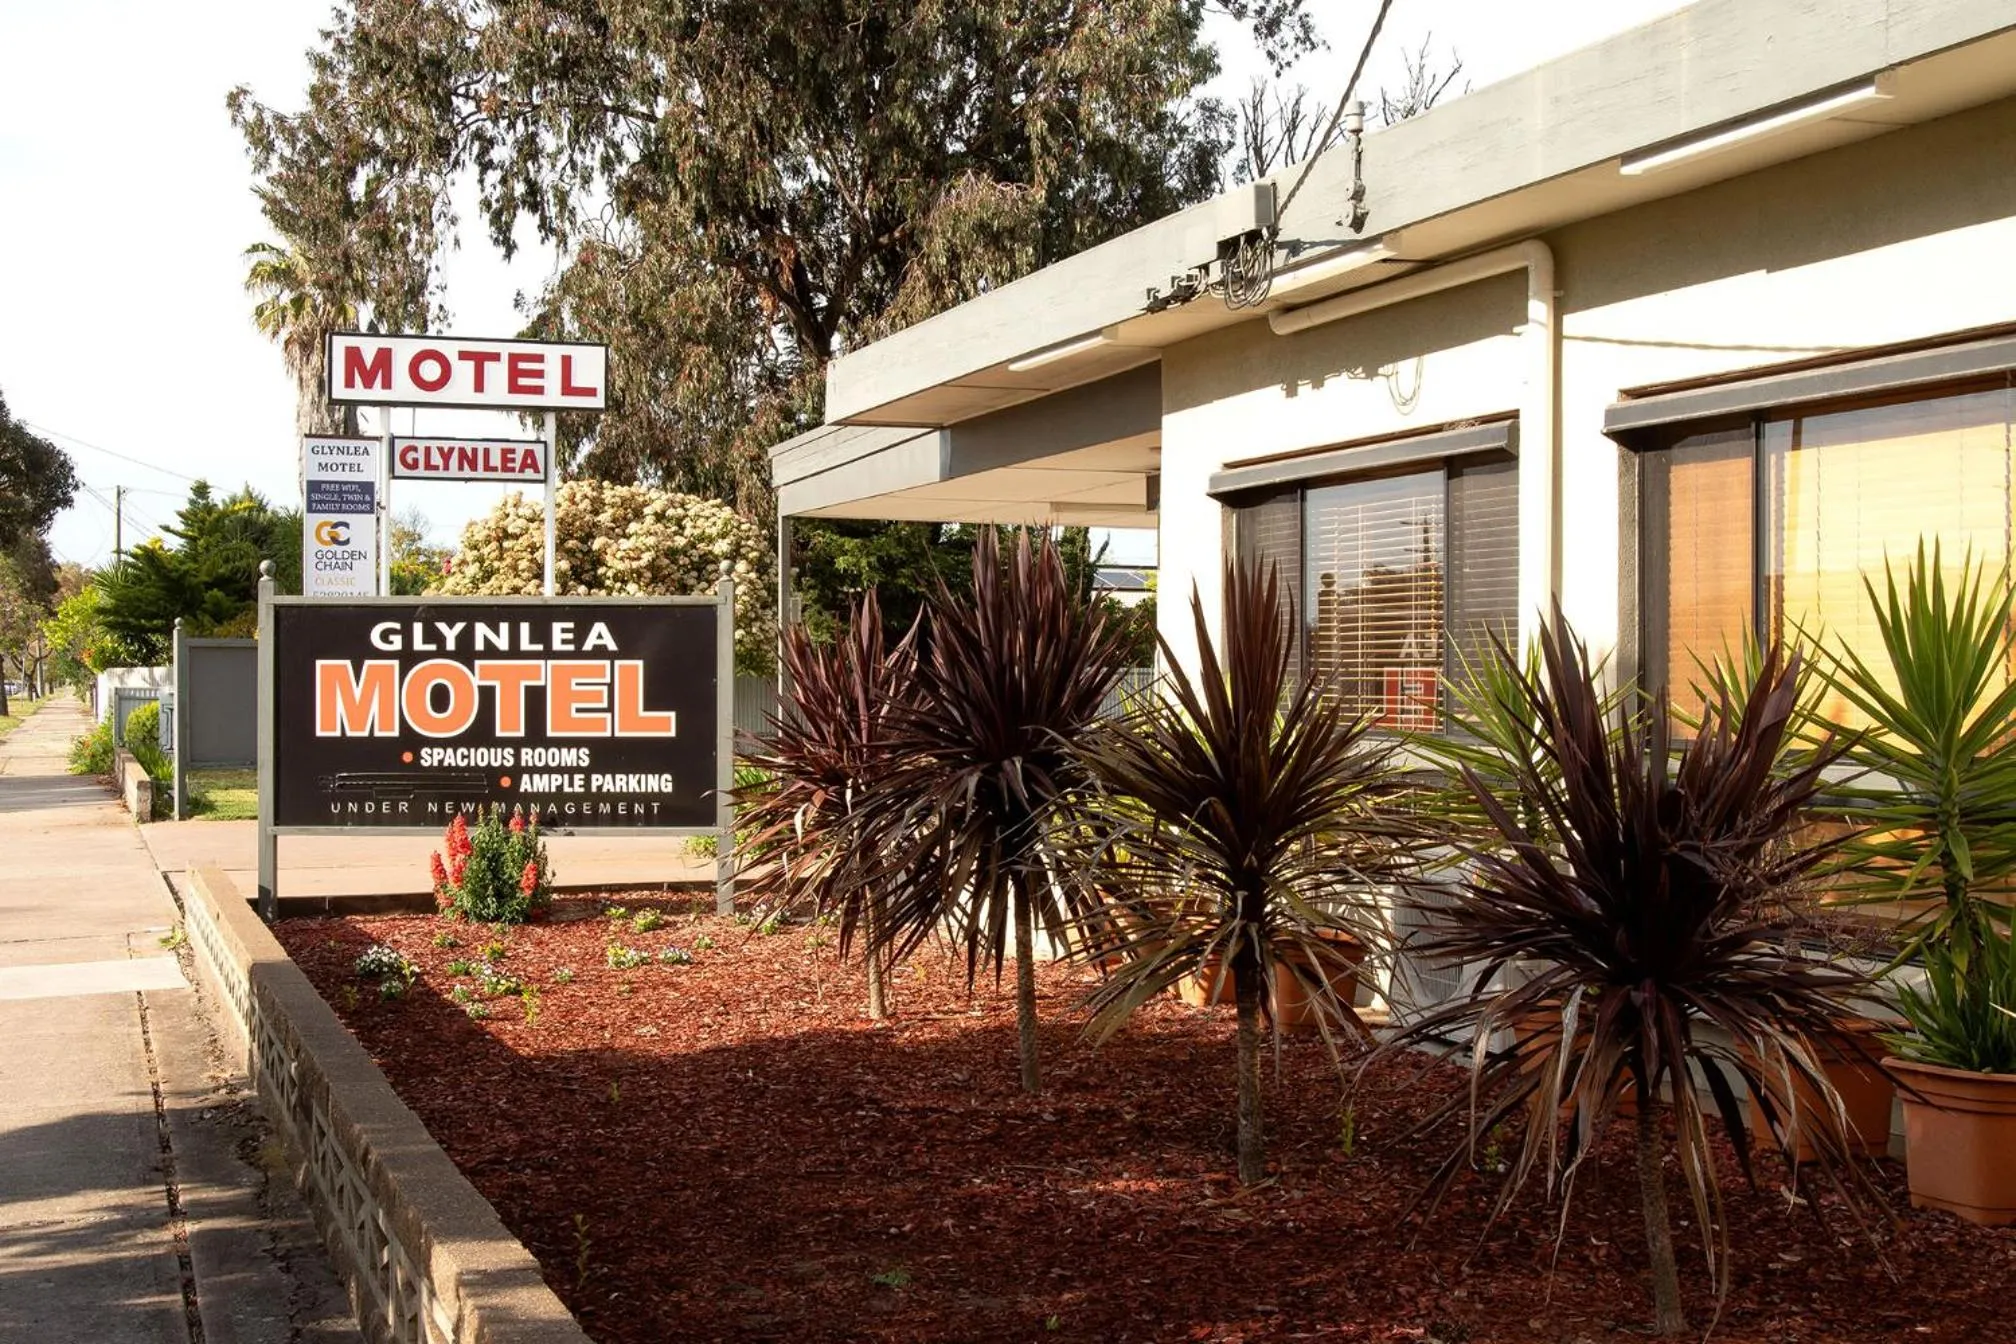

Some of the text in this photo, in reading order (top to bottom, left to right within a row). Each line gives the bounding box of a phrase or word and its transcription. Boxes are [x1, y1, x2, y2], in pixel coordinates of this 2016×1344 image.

[343, 345, 599, 398] MOTEL
[311, 445, 370, 457] GLYNLEA
[399, 444, 541, 474] GLYNLEA
[317, 462, 364, 473] MOTEL
[320, 483, 340, 492] FREE
[311, 503, 371, 511] FAMILY ROOMS
[315, 549, 368, 561] GOLDEN
[315, 561, 353, 572] CHAIN
[315, 577, 357, 587] CLASSIC
[370, 621, 619, 651] GLYNLEA
[315, 658, 677, 738] MOTEL
[420, 747, 590, 767] SPACIOUS ROOMS
[519, 773, 673, 793] AMPLE PARKING
[331, 801, 662, 815] UNDER NEW MANAGEMENT
